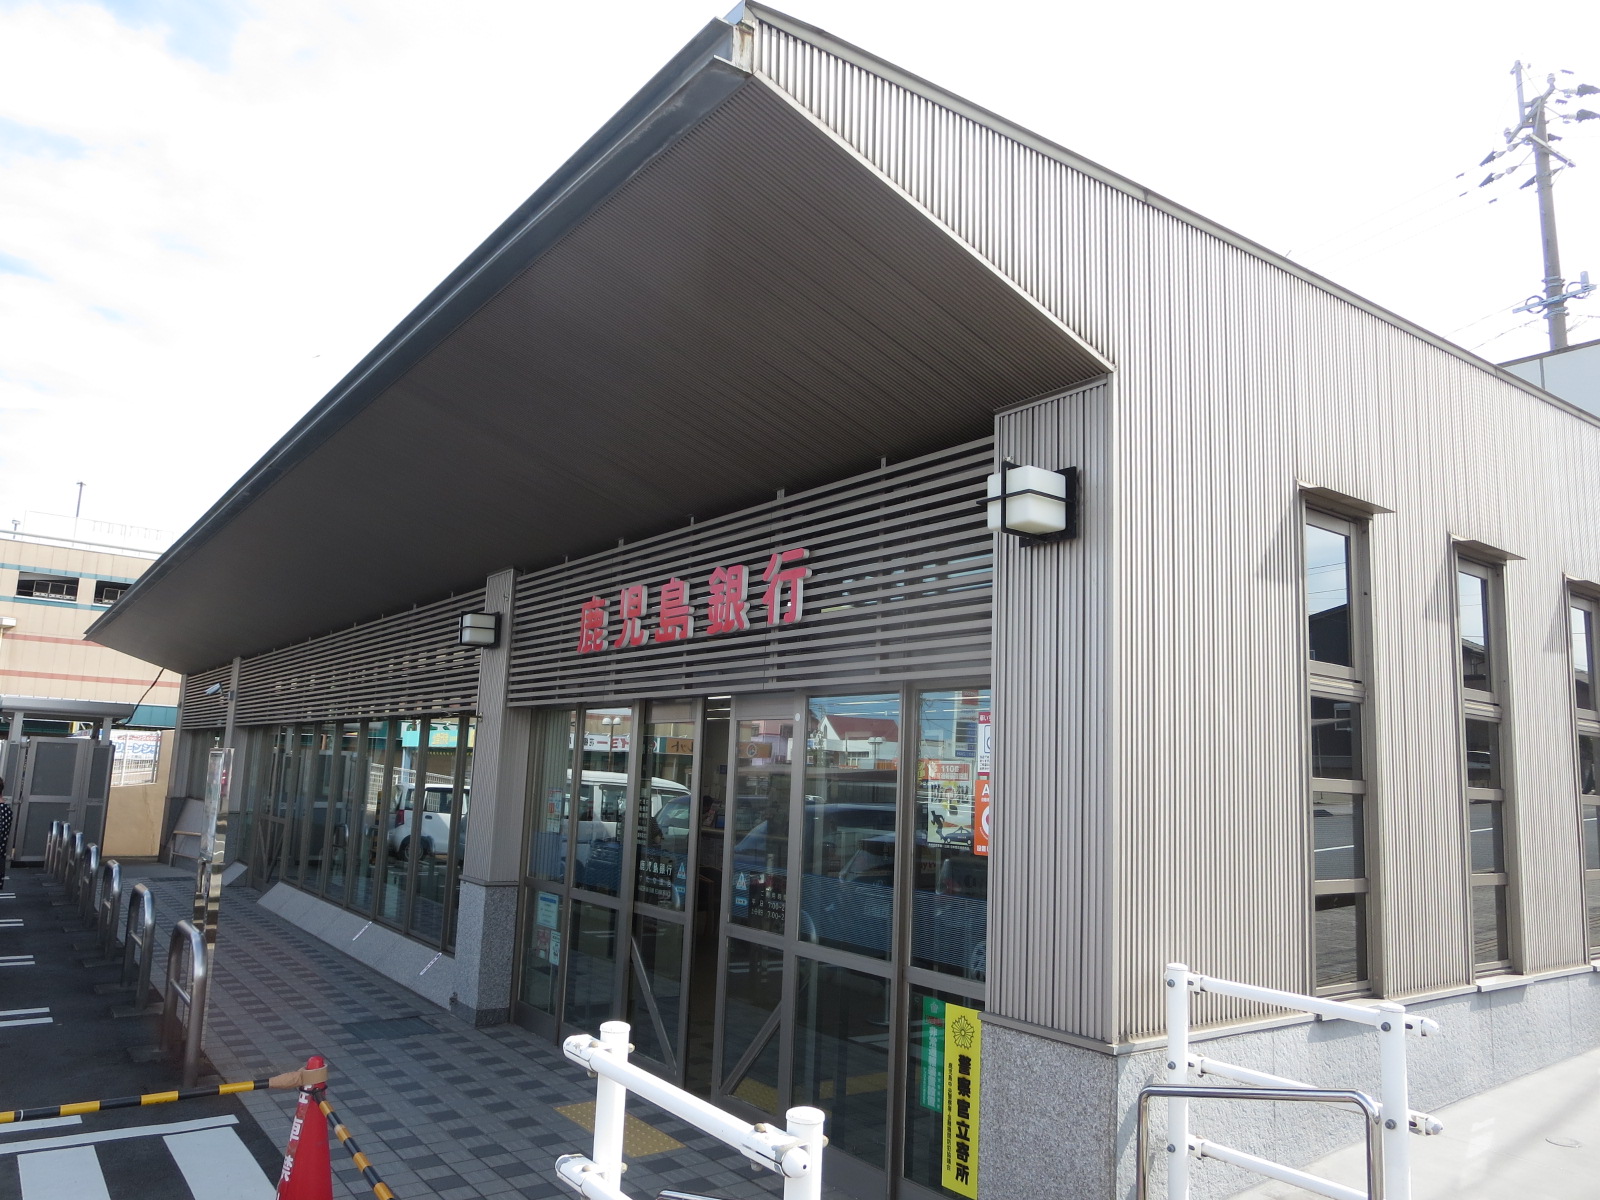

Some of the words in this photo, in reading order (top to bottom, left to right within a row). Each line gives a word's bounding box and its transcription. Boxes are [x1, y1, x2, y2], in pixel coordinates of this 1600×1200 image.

[577, 548, 812, 654] 鹿児島銀行
[639, 859, 673, 876] 鹿児島銀行
[955, 1054, 972, 1186] 警察官立寄所
